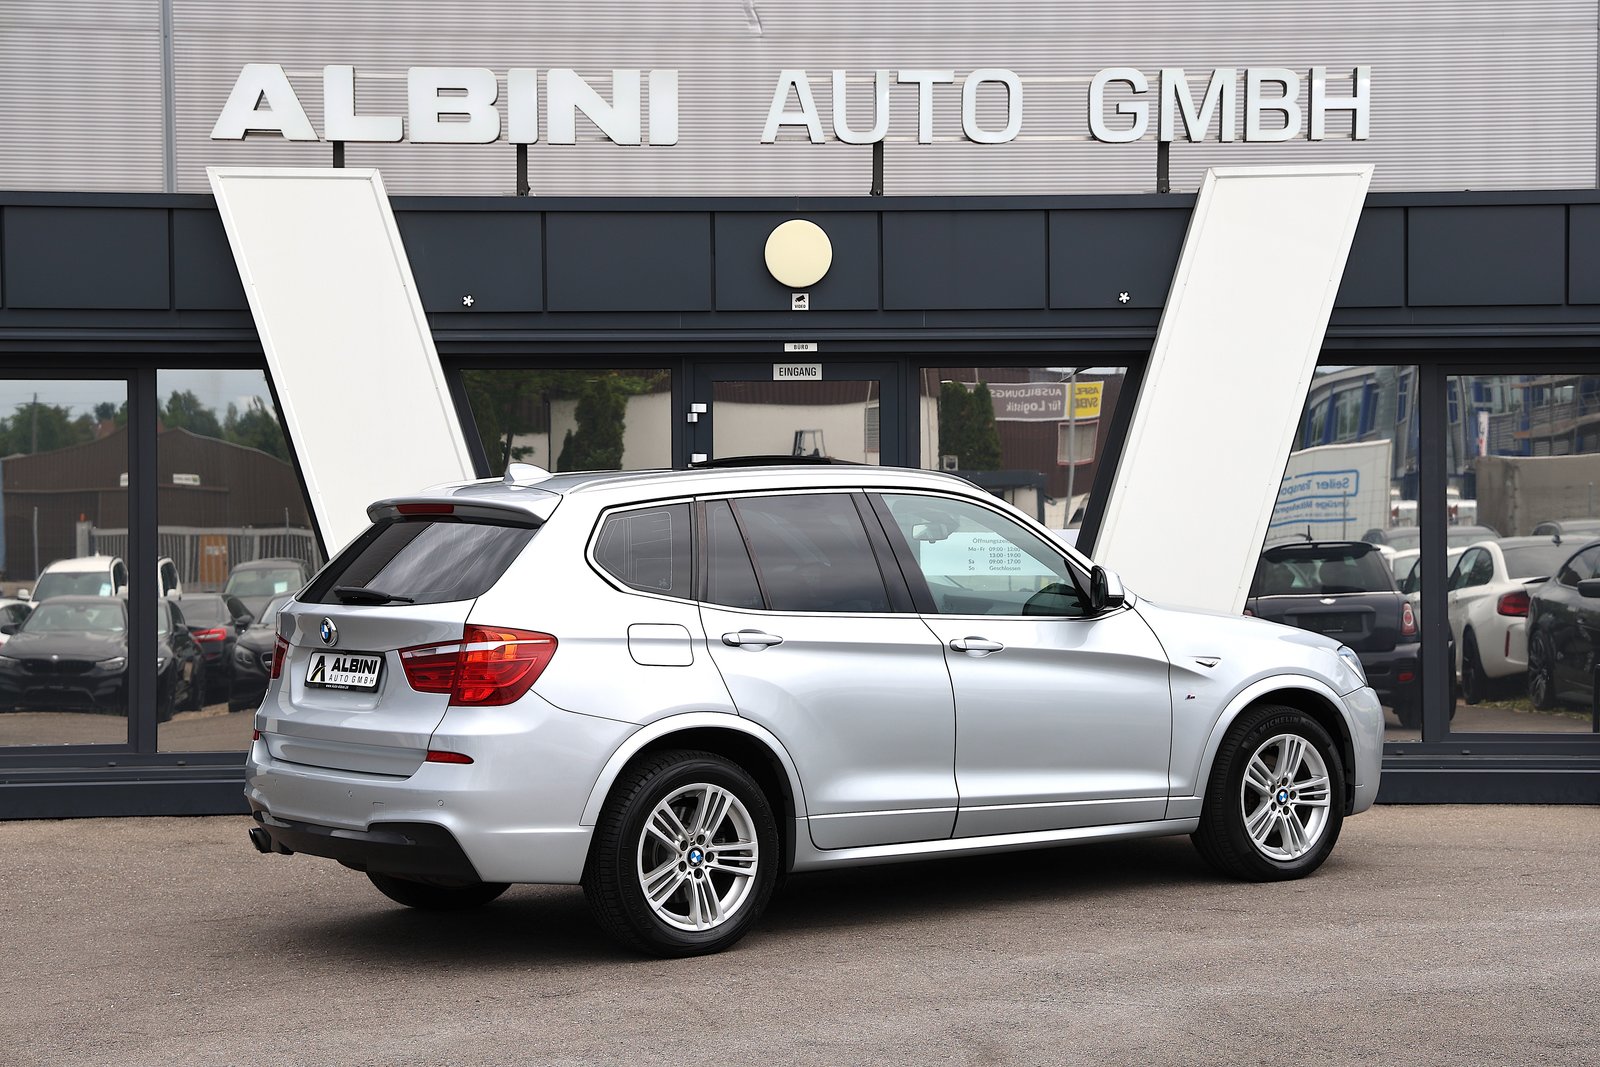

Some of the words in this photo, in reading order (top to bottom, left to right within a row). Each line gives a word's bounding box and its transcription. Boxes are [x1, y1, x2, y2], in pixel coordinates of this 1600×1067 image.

[210, 63, 679, 146] ALBINI
[759, 67, 1025, 145] AUTO
[1088, 65, 1372, 144] GMBH
[779, 367, 817, 377] EINGANG
[331, 657, 378, 675] ALBINI
[328, 674, 349, 683] AUTO
[351, 675, 375, 684] GMBH
[1259, 716, 1301, 732] MICHELIN
